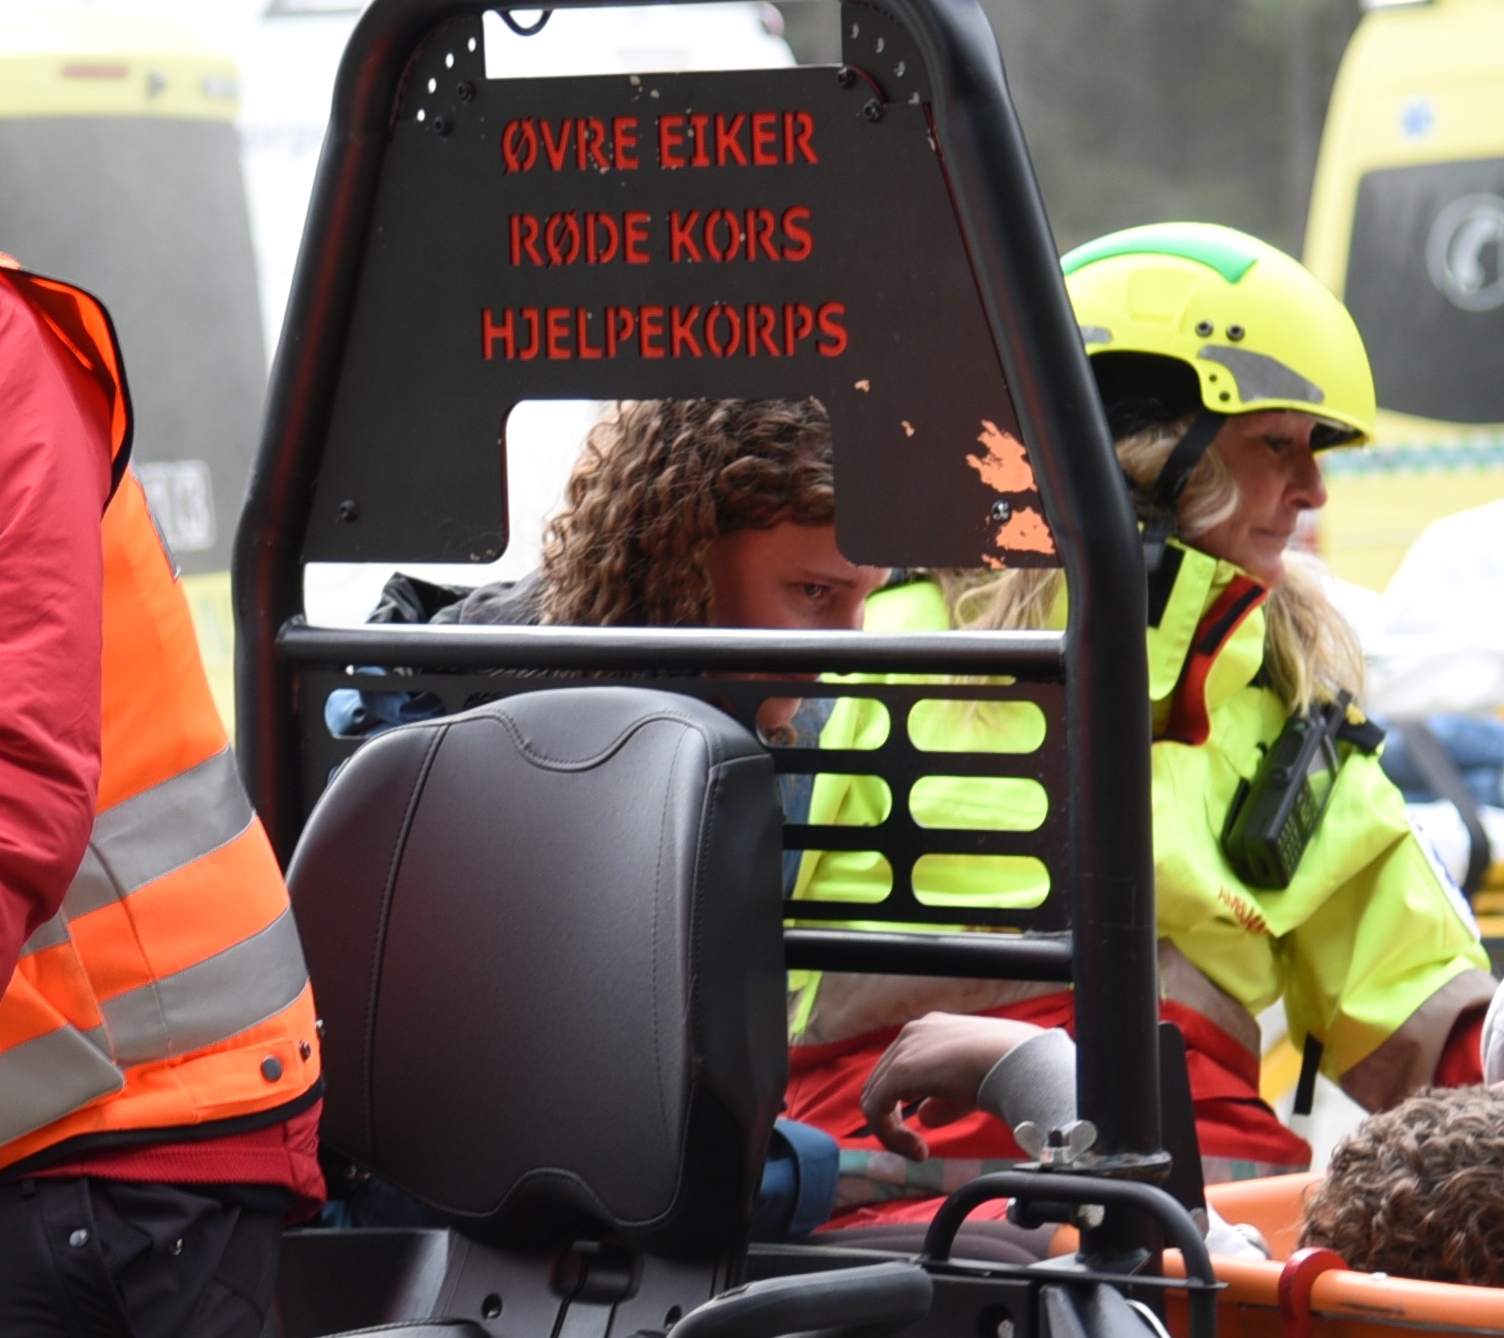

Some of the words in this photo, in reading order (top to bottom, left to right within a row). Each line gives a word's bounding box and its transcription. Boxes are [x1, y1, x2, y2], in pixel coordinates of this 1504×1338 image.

[501, 115, 640, 175] ØVRE
[657, 111, 820, 170] EIKER
[509, 209, 651, 268] RØDE
[668, 206, 813, 263] KORS
[480, 301, 848, 360] HJELPEKORPS
